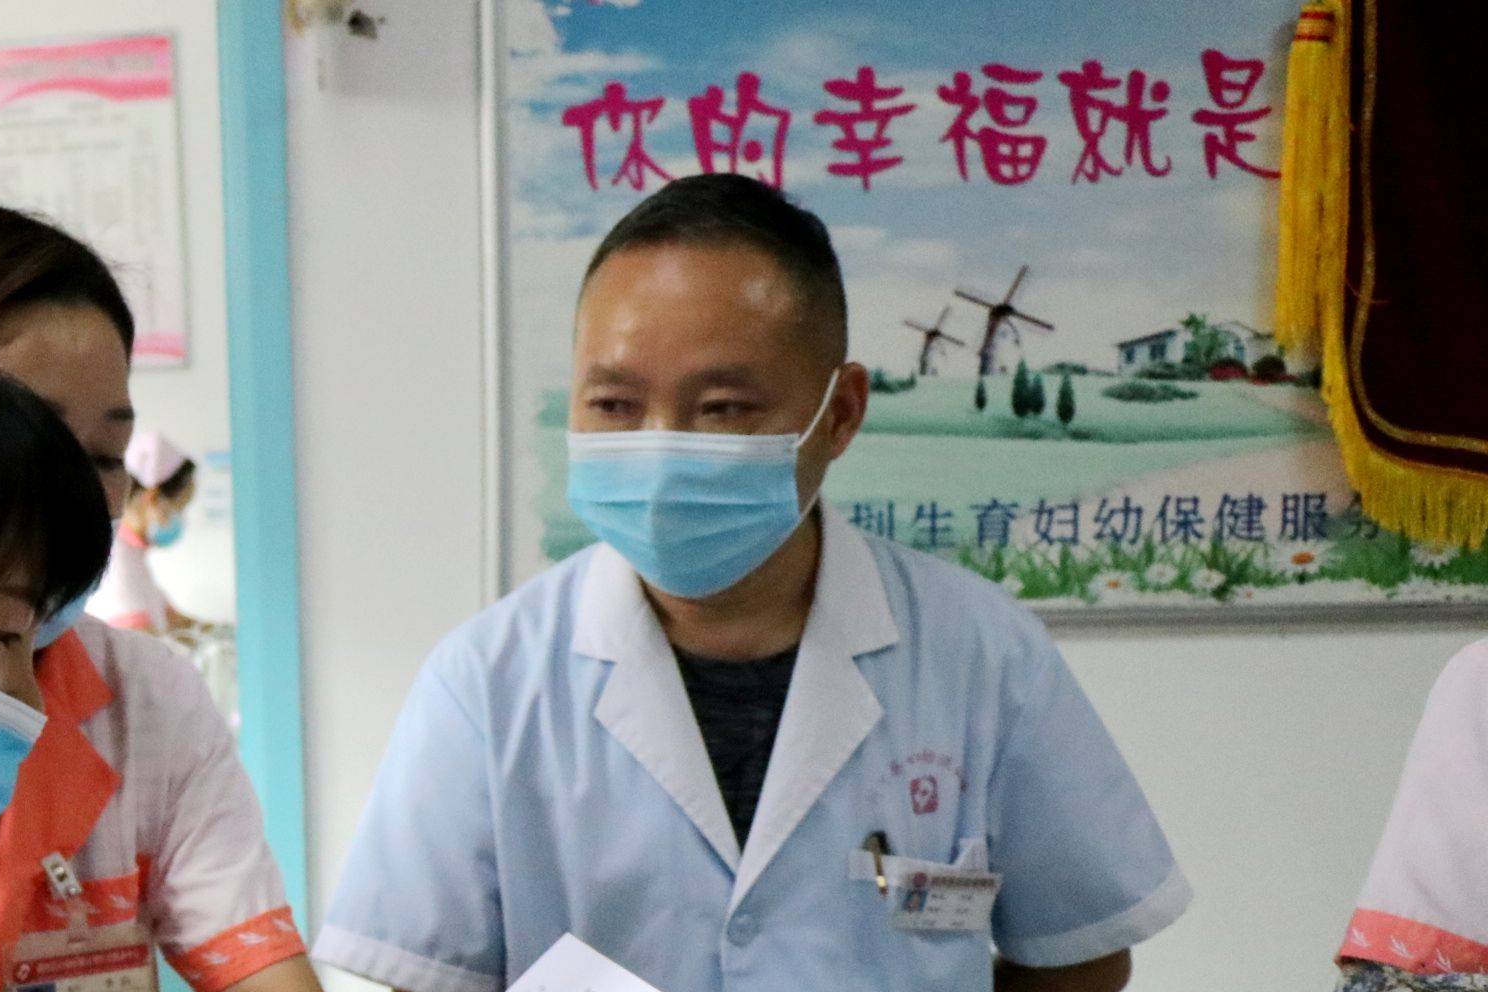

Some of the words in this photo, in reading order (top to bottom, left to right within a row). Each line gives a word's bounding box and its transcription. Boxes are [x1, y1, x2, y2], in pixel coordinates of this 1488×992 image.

[562, 48, 1281, 191] 你的幸福就是
